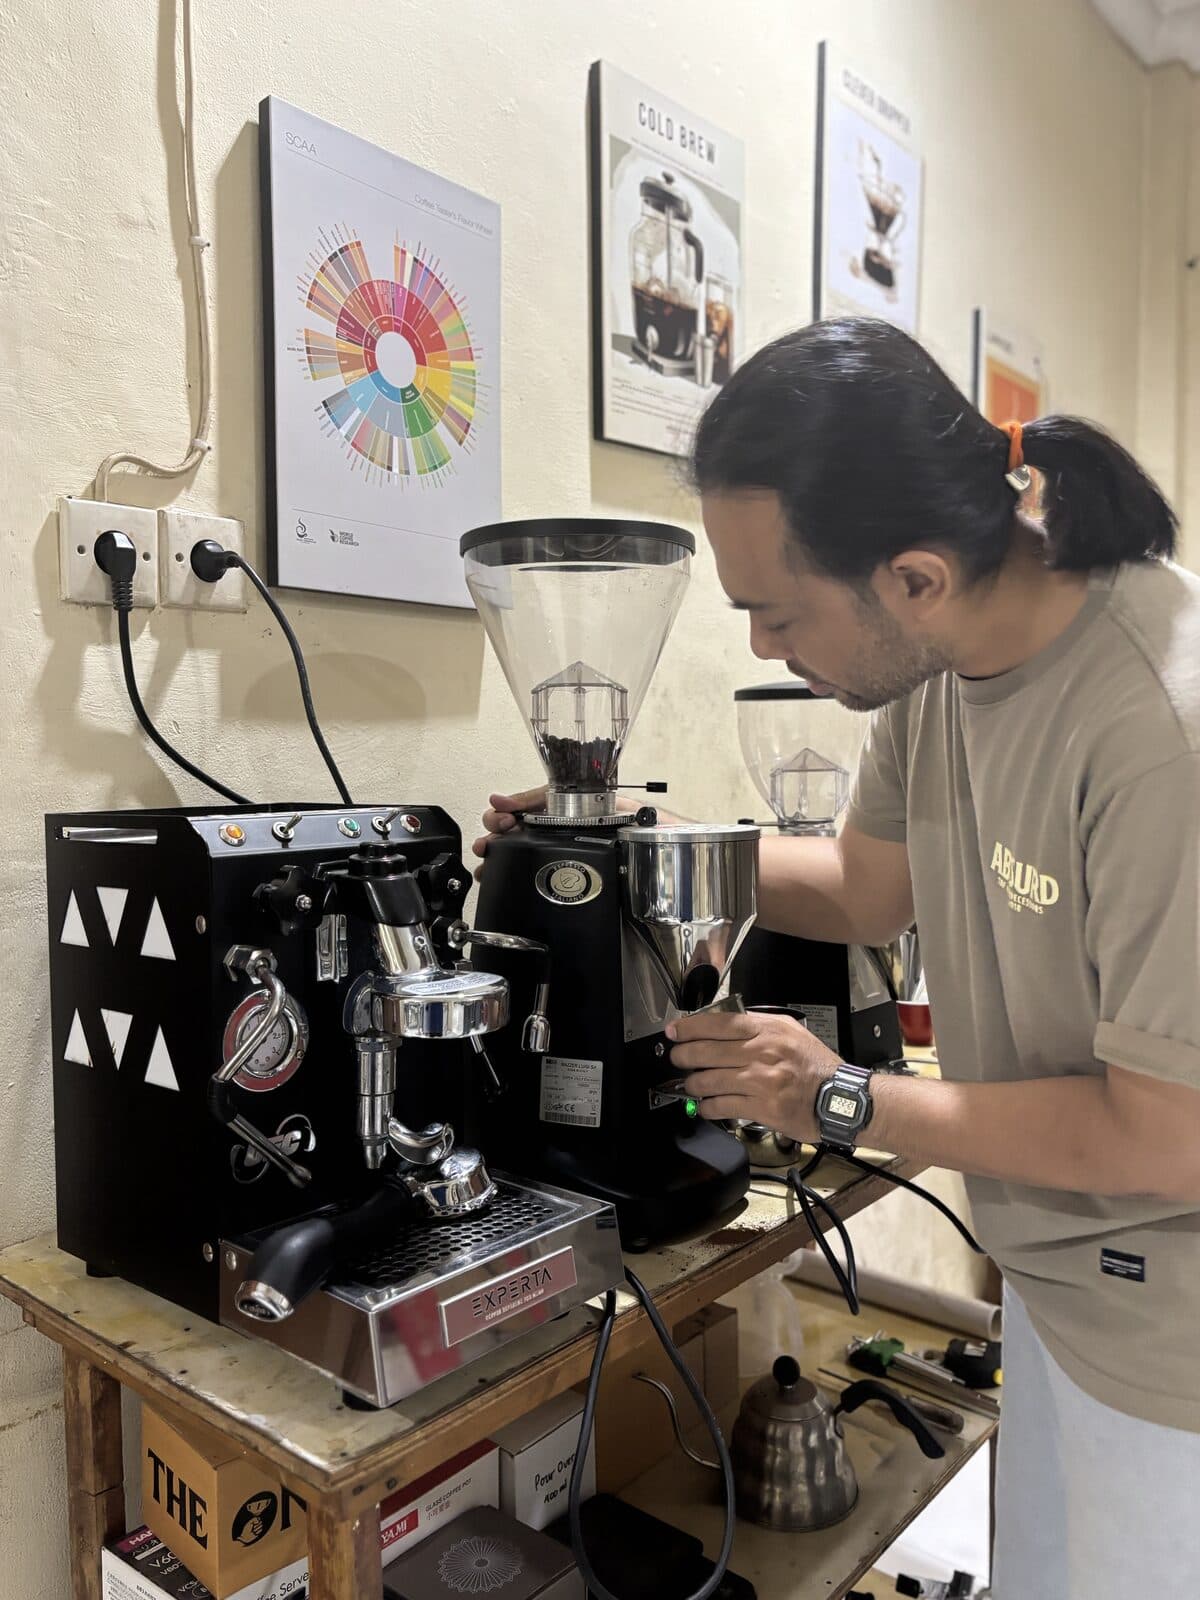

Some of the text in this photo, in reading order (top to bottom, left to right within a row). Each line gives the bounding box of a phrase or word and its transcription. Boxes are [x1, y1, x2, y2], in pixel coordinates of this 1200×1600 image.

[285, 131, 318, 156] SCAA
[638, 102, 674, 141] COLD
[679, 125, 716, 165] BREW
[990, 841, 1059, 905] ABSURD
[471, 1267, 552, 1316] EXPERTA
[147, 1447, 208, 1550] THE
[425, 1477, 473, 1512] GLASS COFFEE POT
[535, 1469, 556, 1491] Pour
[279, 1571, 310, 1597] Serve
